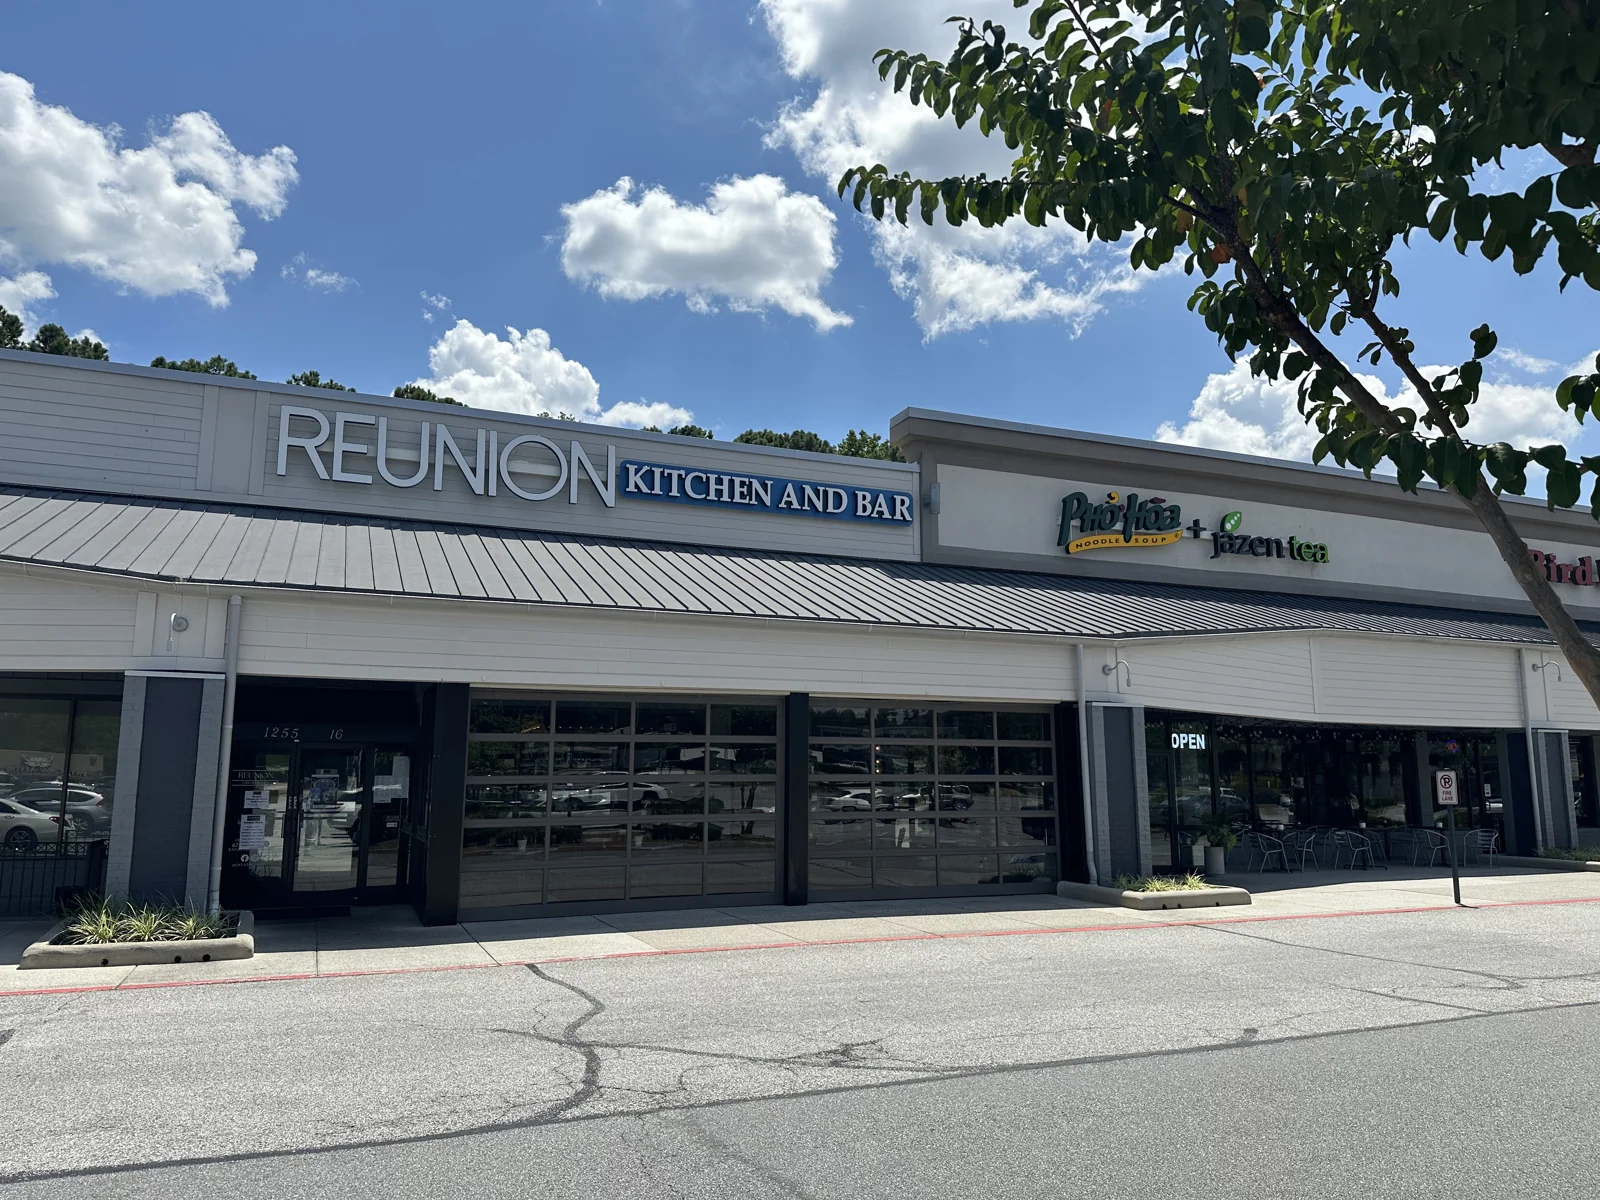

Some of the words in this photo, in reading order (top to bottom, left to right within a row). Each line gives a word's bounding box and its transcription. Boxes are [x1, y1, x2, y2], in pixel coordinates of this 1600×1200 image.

[276, 403, 617, 508] REUNION
[625, 463, 774, 507] KITCHEN
[779, 483, 850, 515] AND
[854, 491, 914, 522] BAR
[1075, 537, 1121, 549] NOODLE
[1210, 530, 1286, 559] jazen
[1288, 535, 1331, 564] tea
[264, 727, 299, 739] 1255
[329, 728, 343, 740] 16
[1171, 732, 1206, 750] OPEN
